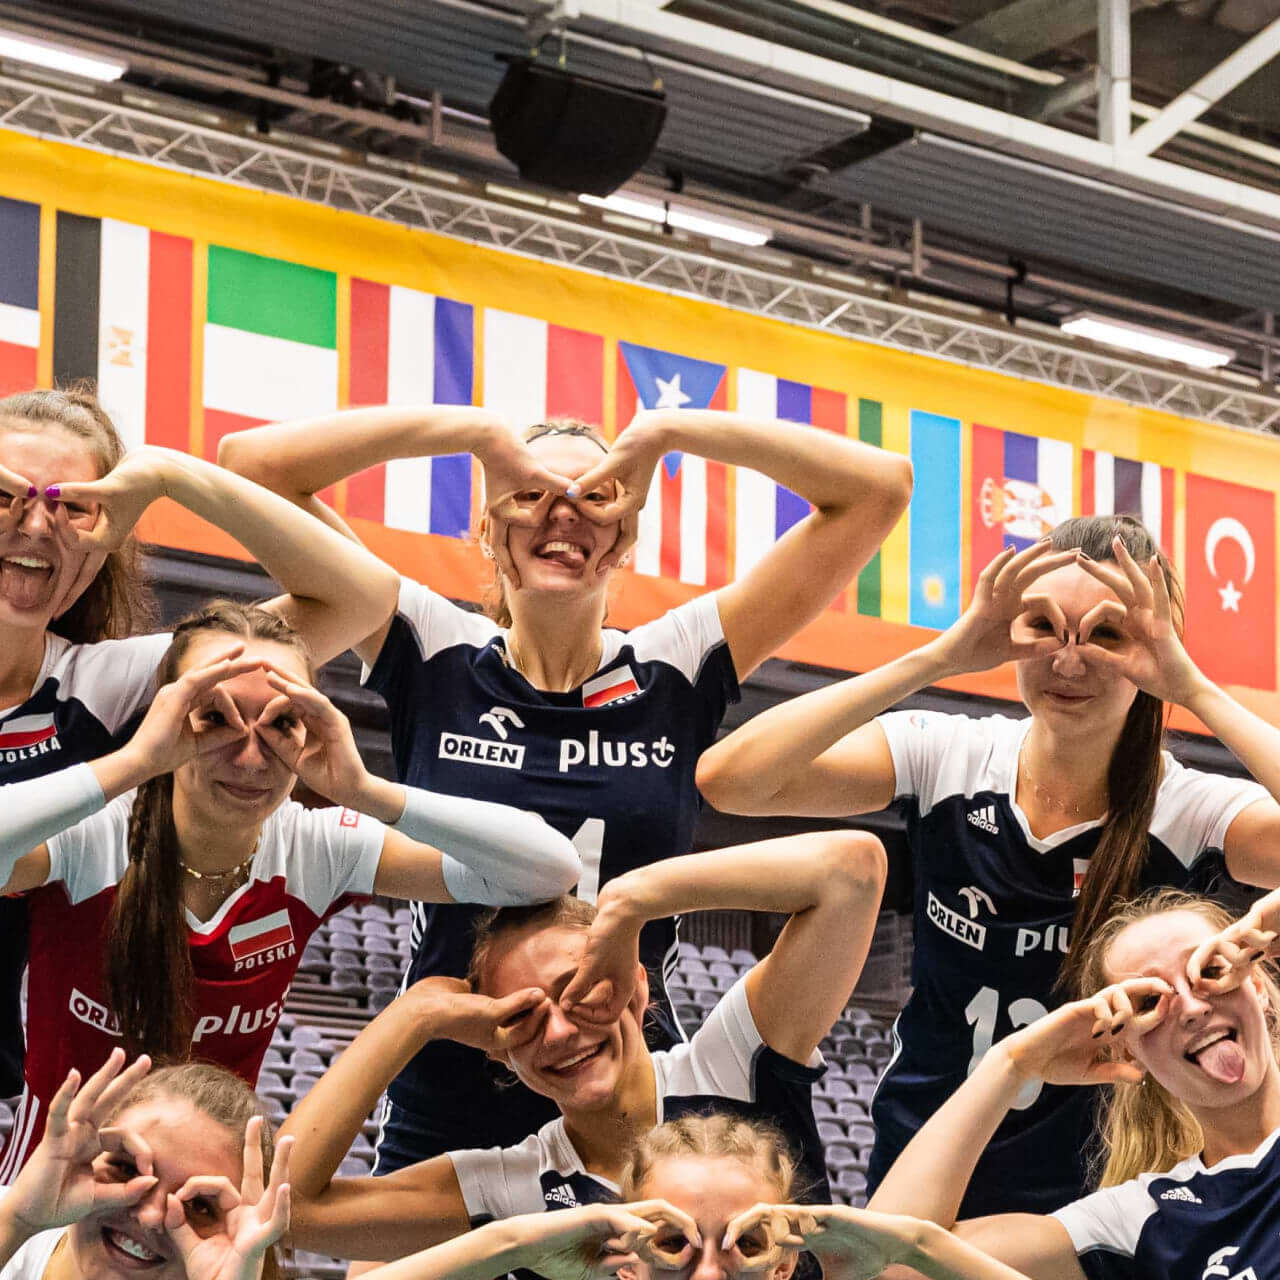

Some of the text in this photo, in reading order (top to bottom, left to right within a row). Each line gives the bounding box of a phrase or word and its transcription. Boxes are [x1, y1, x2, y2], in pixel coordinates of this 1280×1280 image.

[444, 730, 645, 773] ORLEN plus
[967, 811, 1000, 835] adidas
[930, 901, 1071, 957] ORLEN plu
[234, 944, 297, 973] POLSKA
[191, 1004, 277, 1042] plus
